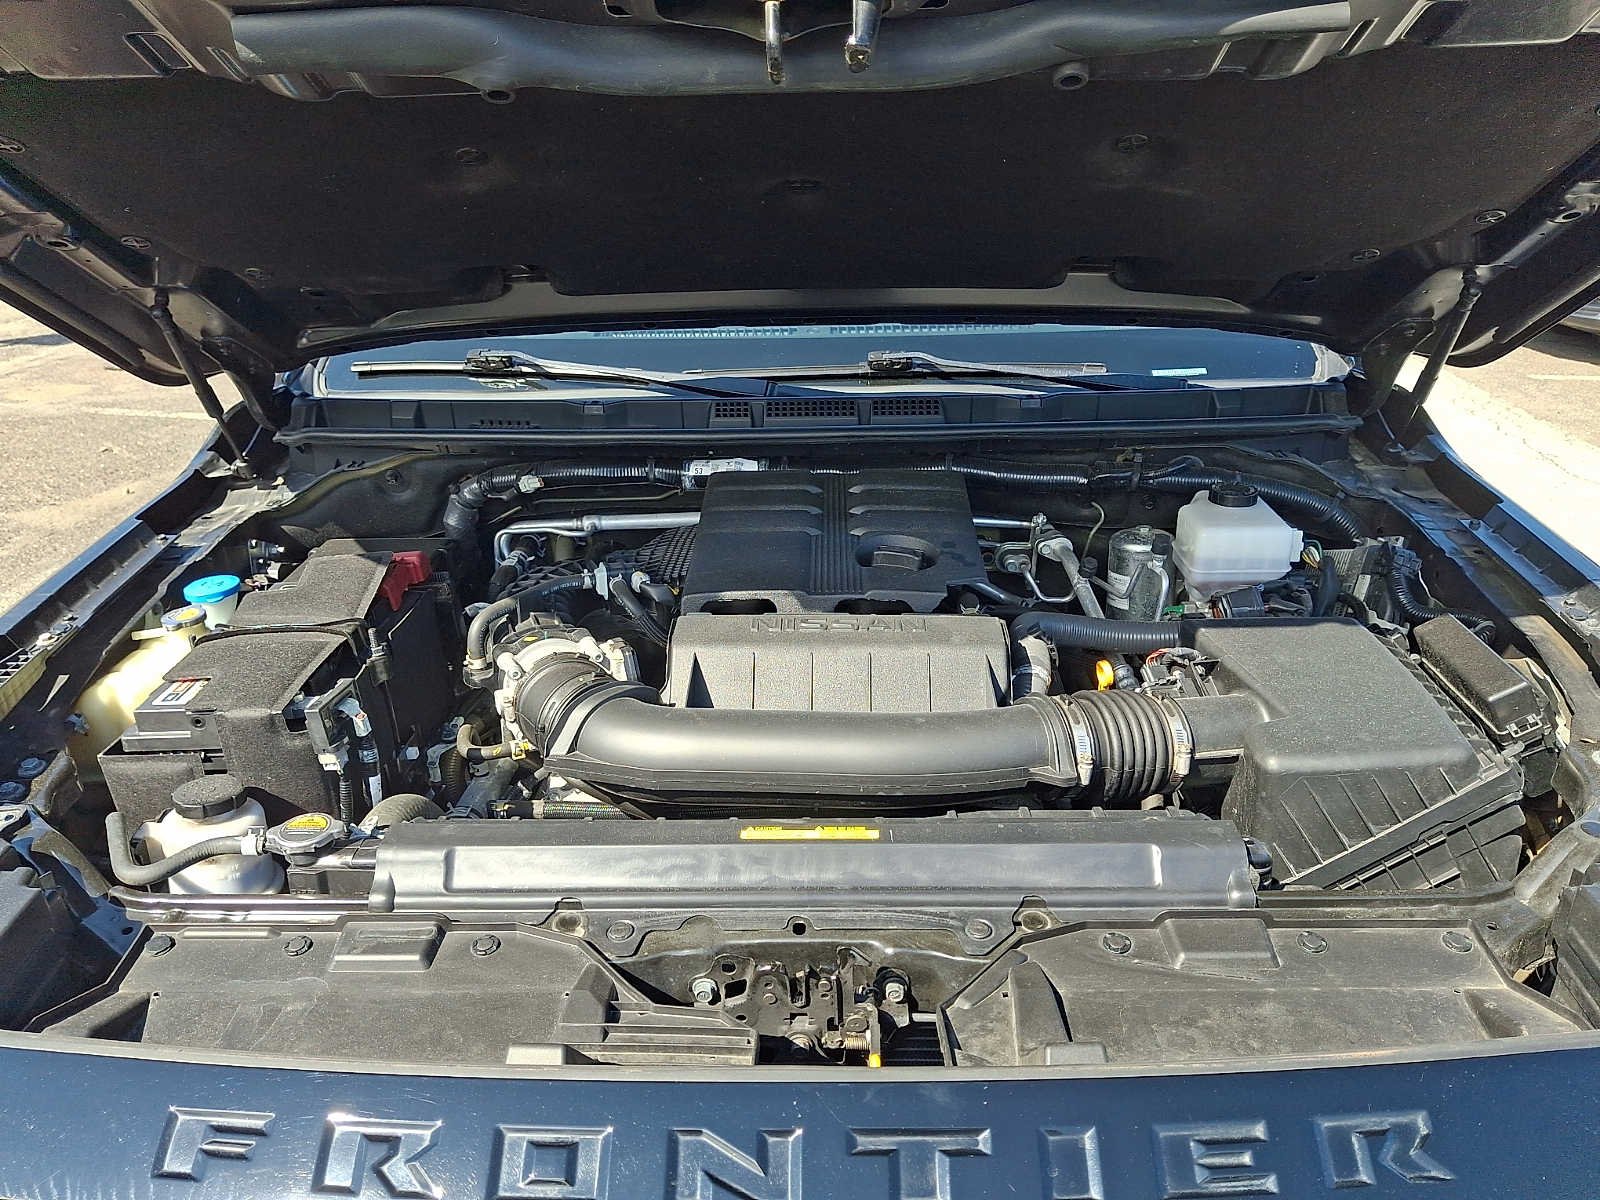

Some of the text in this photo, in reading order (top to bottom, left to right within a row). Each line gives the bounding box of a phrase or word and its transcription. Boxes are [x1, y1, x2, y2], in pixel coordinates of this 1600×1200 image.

[694, 467, 704, 475] 53
[750, 617, 927, 632] NISSAN
[152, 1105, 1454, 1200] FRONTIER
